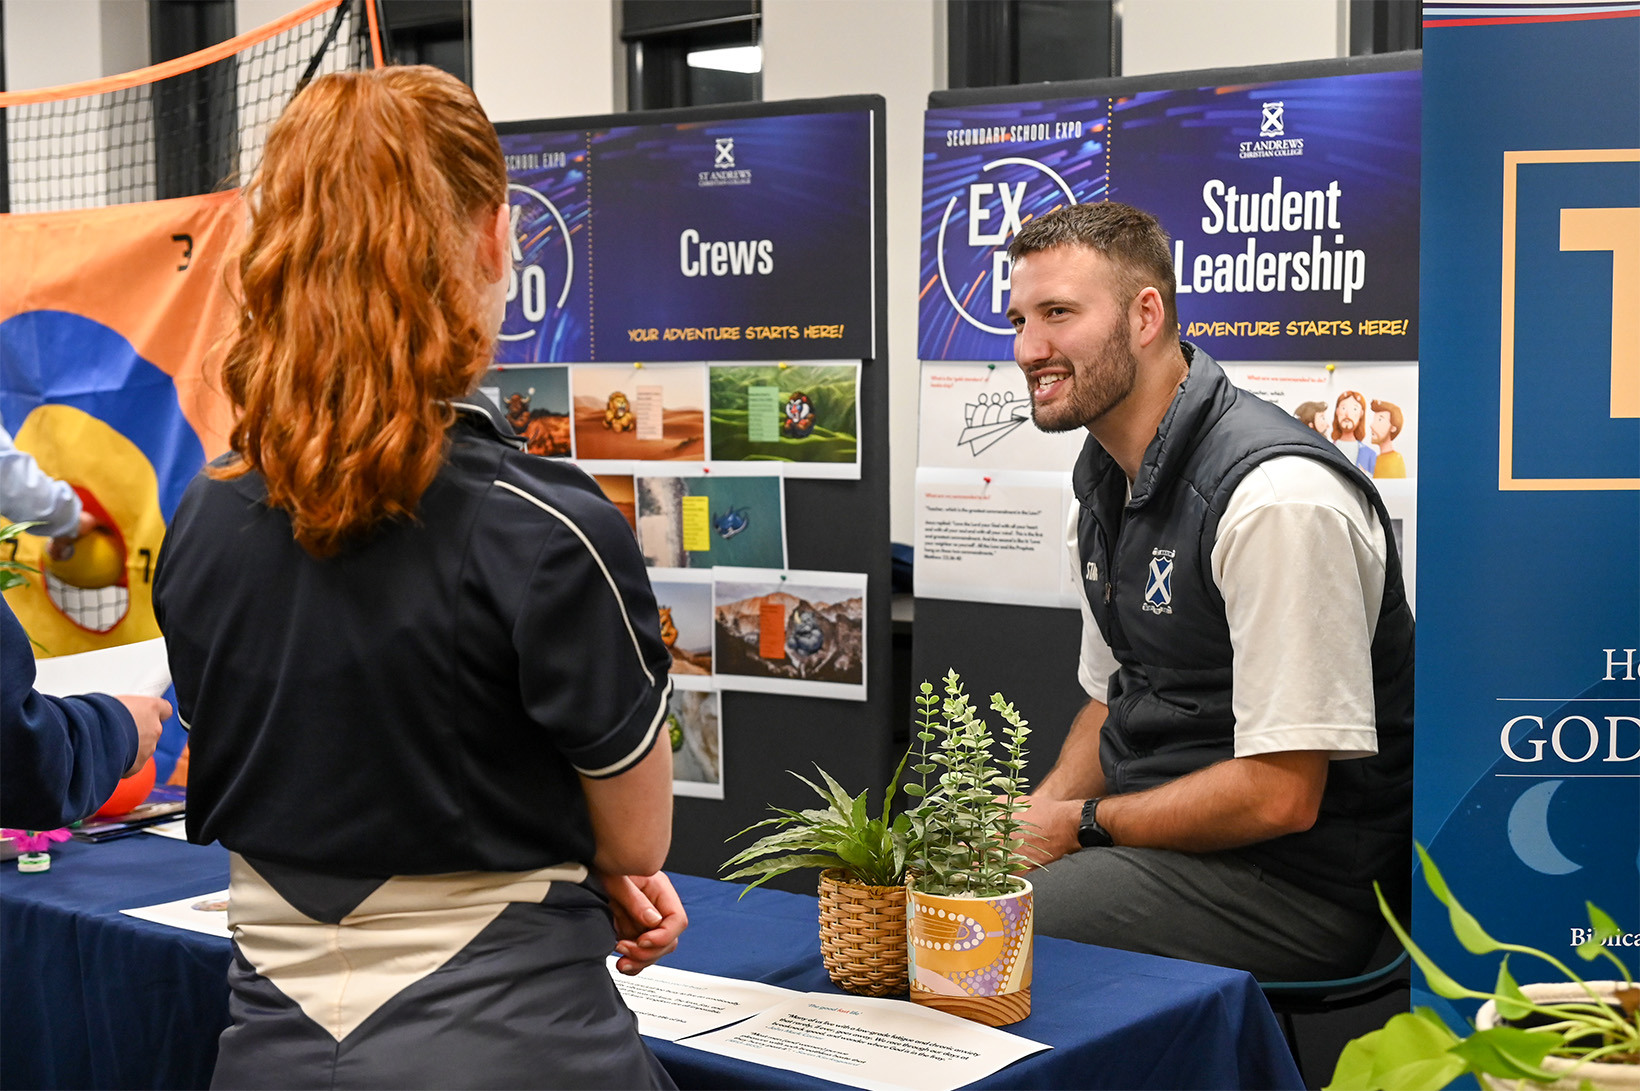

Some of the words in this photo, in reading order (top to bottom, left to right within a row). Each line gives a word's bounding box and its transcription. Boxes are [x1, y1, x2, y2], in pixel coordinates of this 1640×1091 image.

[946, 126, 1006, 147] SECONDARY
[1010, 124, 1050, 142] SCHOOL
[1056, 121, 1082, 139] EXPO
[1240, 142, 1253, 152] ST
[1253, 138, 1304, 150] ANDREWS
[505, 153, 539, 170] SCHOOL
[542, 152, 566, 168] EXPO
[1239, 150, 1274, 159] CHRISTIAN
[710, 170, 752, 180] ANDREWS
[968, 182, 1027, 246] EX
[1202, 176, 1342, 234] Student
[171, 234, 193, 272] 3
[680, 228, 774, 278] Crews
[1174, 234, 1366, 304] Leadership
[628, 328, 659, 342] YOUR
[662, 326, 740, 341] ADVENTURE
[745, 326, 800, 340] STARTS
[804, 324, 844, 339] HERE!
[1186, 320, 1281, 336] ADVENTURE
[1286, 320, 1353, 336] STARTS
[1358, 319, 1409, 336] HERE!
[1602, 648, 1640, 681] H
[1500, 716, 1640, 763] GOD
[1570, 928, 1640, 947] Bilica
